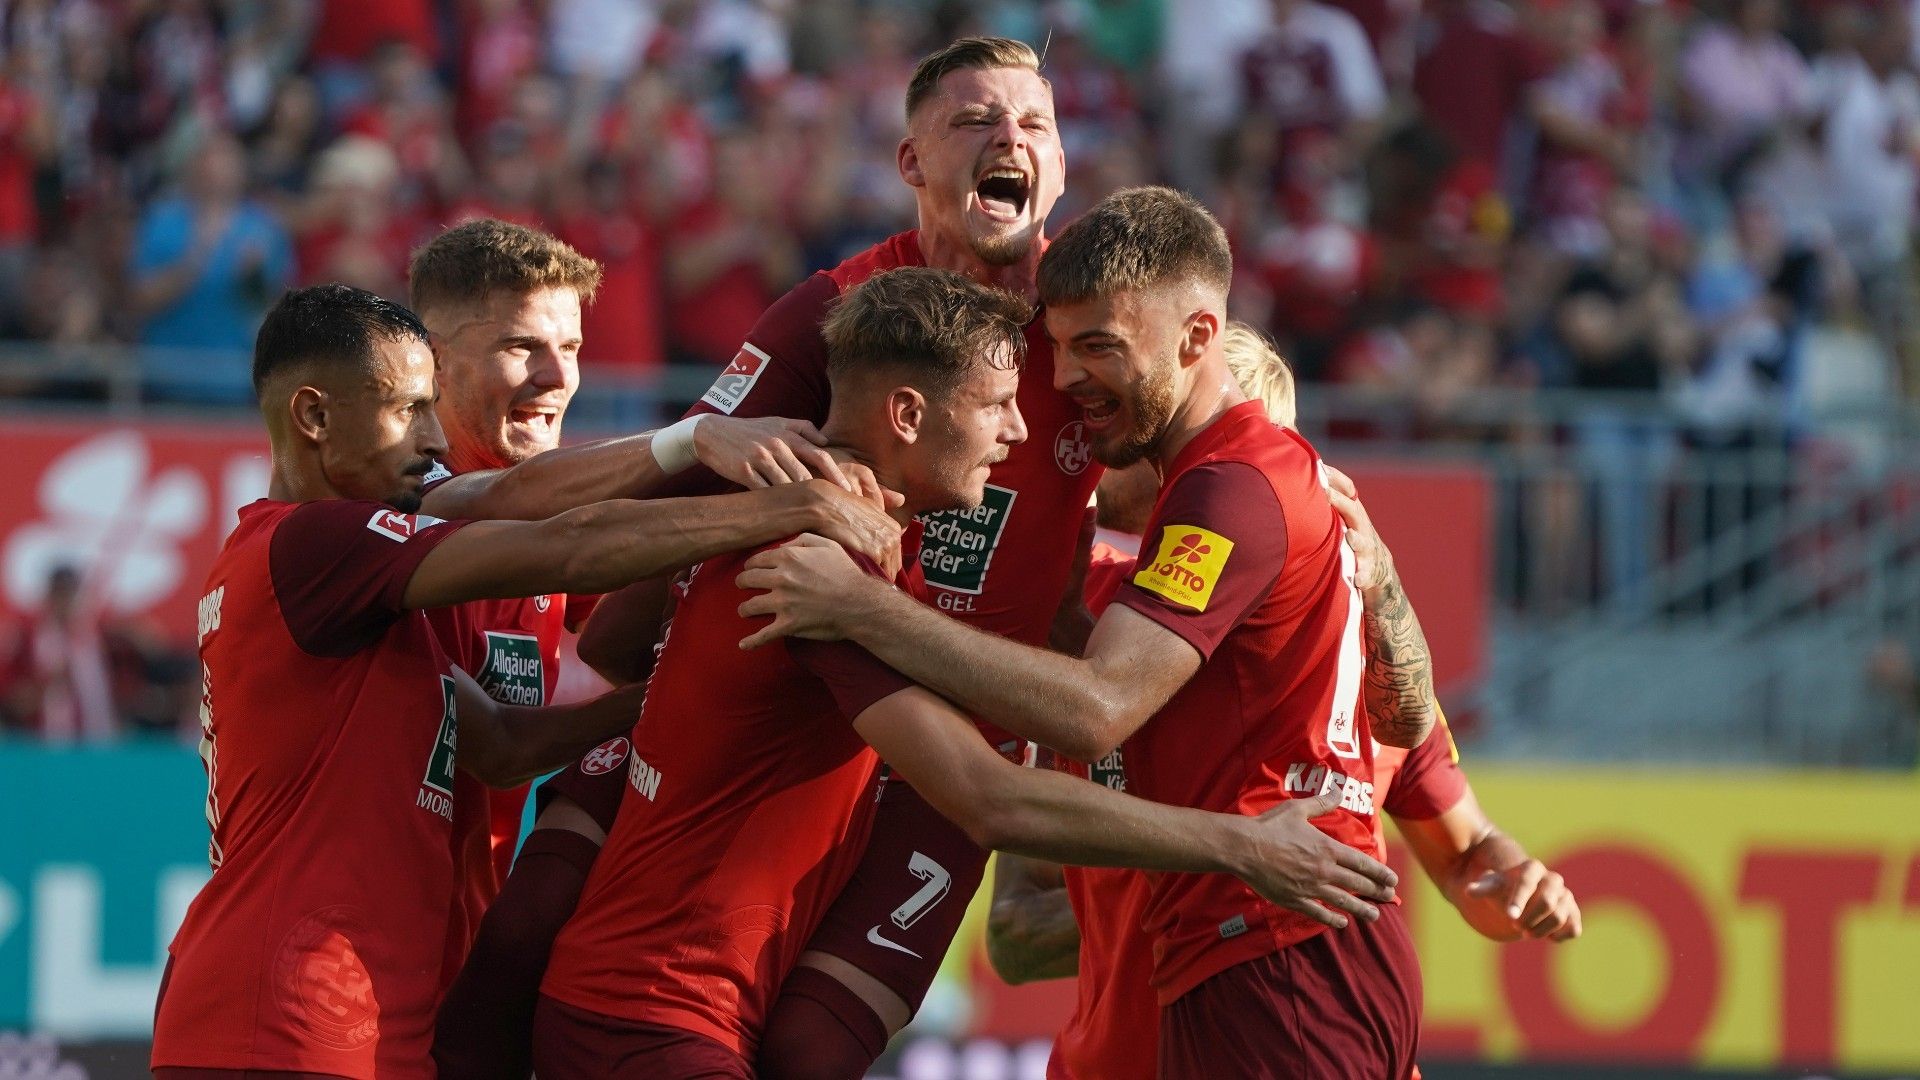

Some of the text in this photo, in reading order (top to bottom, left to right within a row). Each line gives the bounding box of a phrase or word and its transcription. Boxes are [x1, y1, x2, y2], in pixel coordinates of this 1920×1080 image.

[937, 592, 977, 612] GEL
[491, 648, 540, 680] Allgäuer
[890, 850, 952, 931] 7
